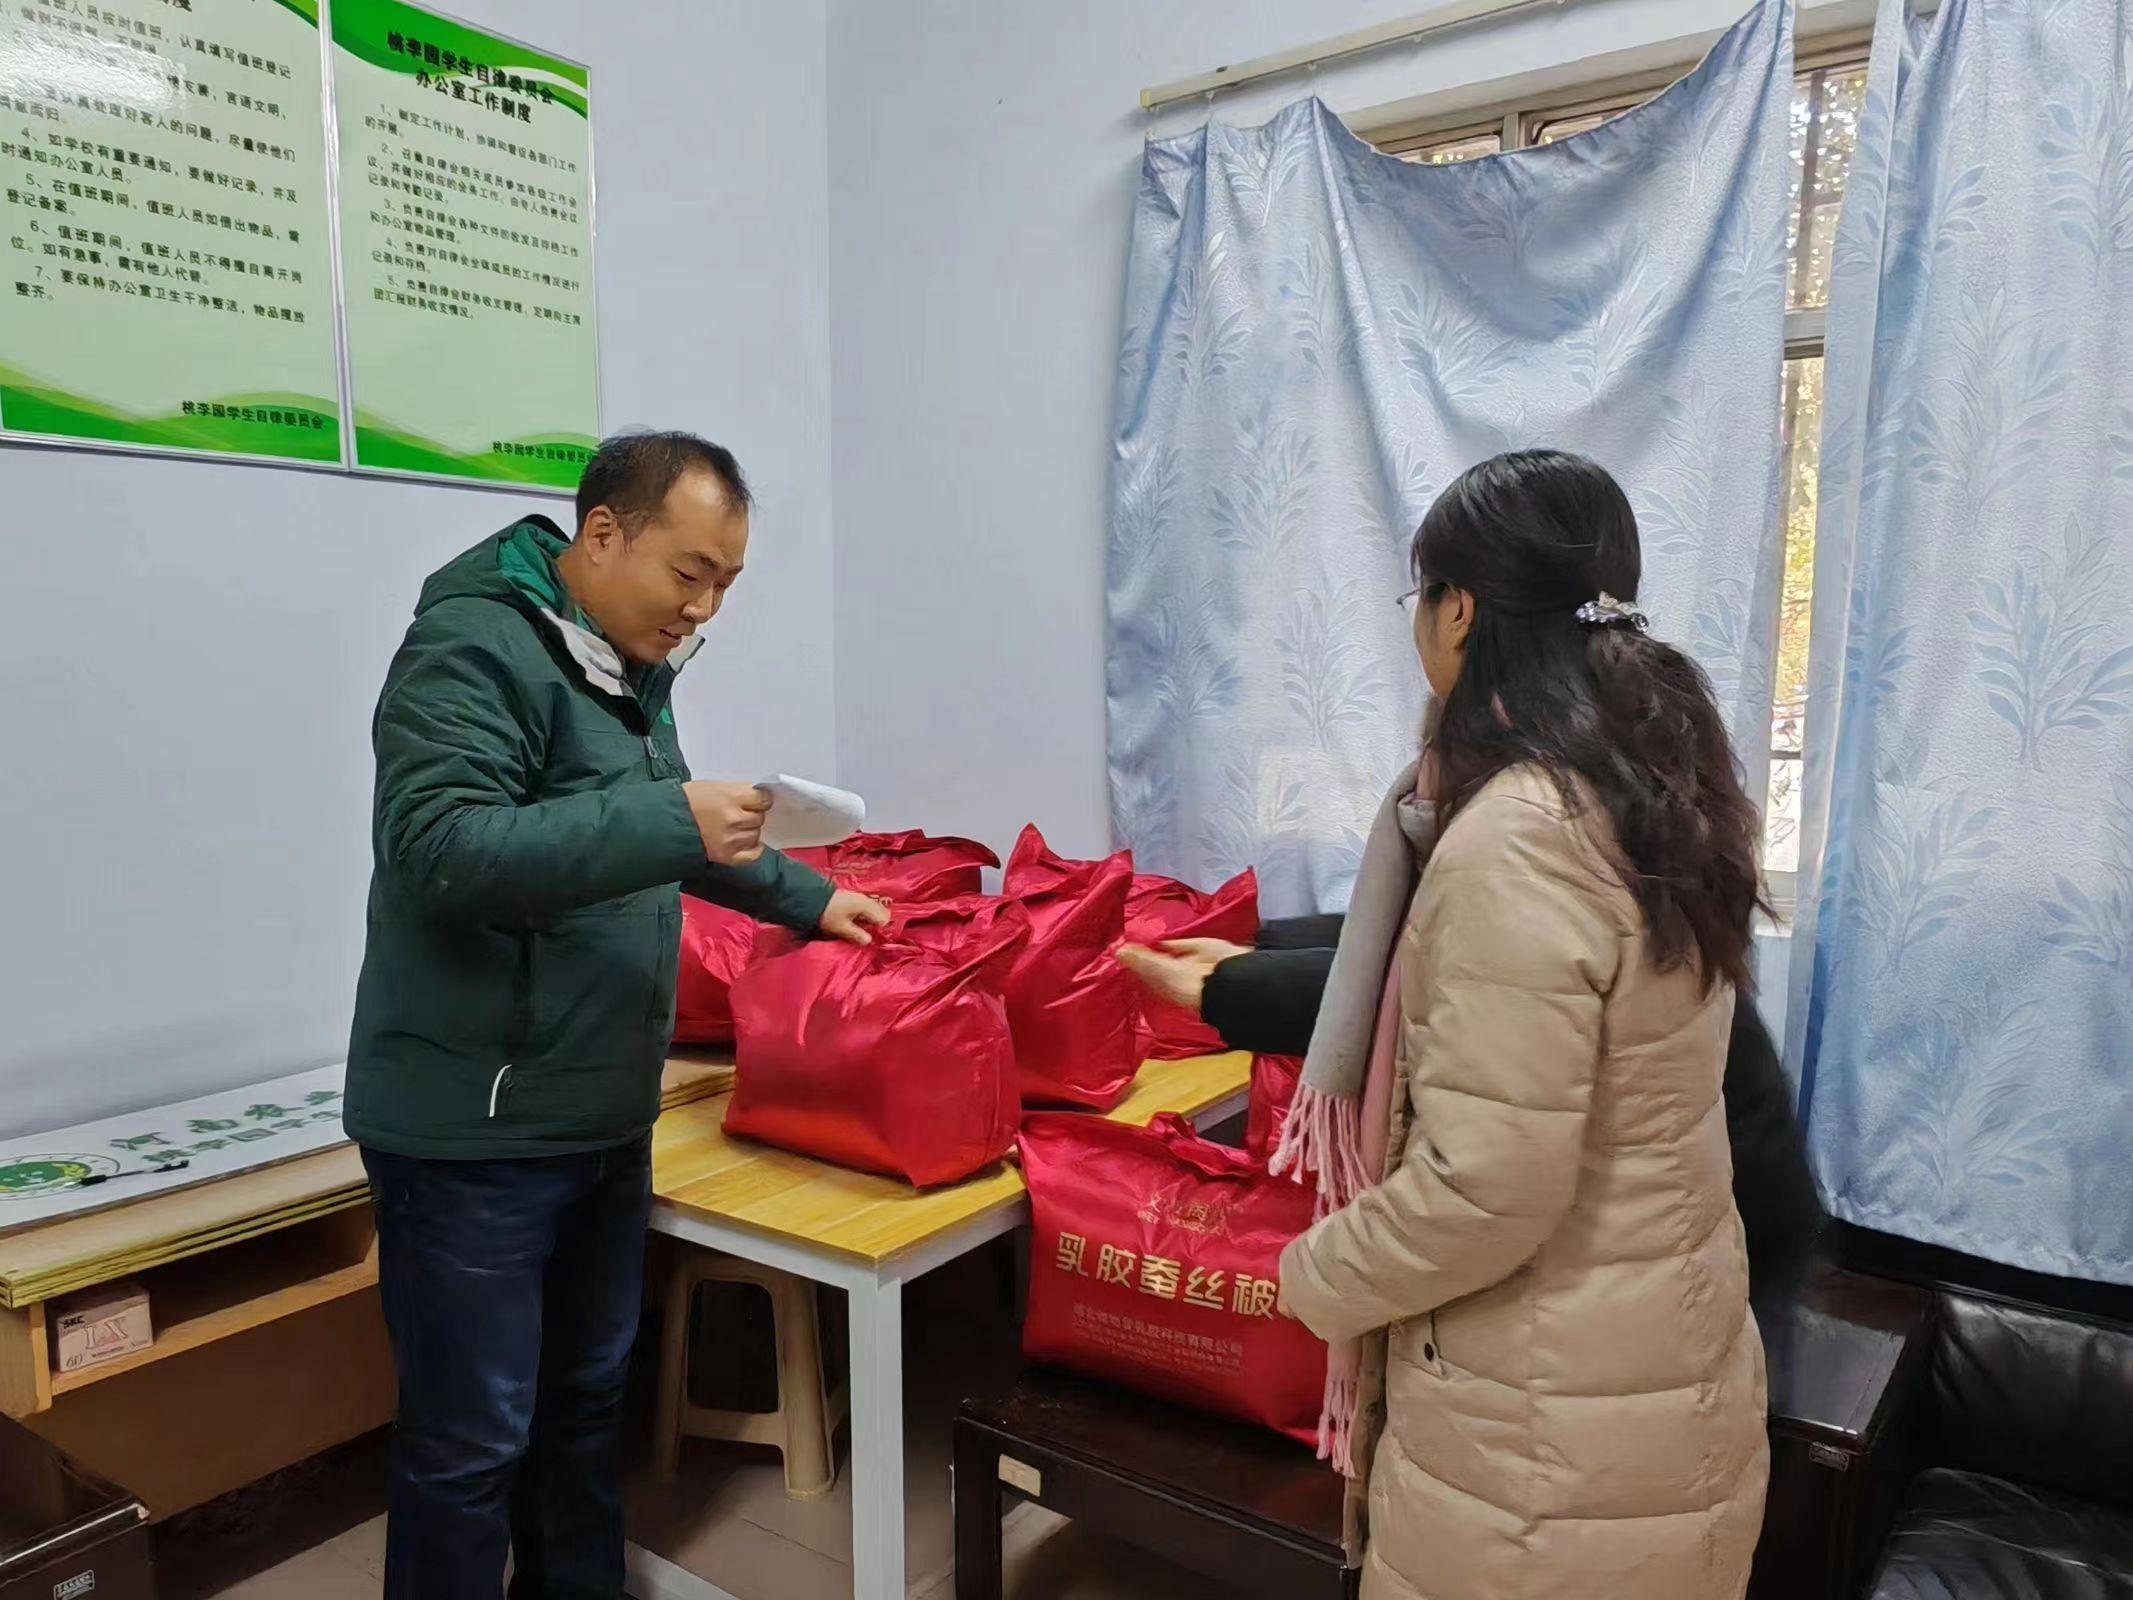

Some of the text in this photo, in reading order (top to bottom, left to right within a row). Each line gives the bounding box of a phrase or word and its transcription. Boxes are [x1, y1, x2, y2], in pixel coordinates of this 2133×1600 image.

[416, 68, 532, 124] 办公室工作制度
[182, 400, 324, 430] 桃李园学生自律委员会
[1056, 1231, 1277, 1320] 乳胶蚕丝被
